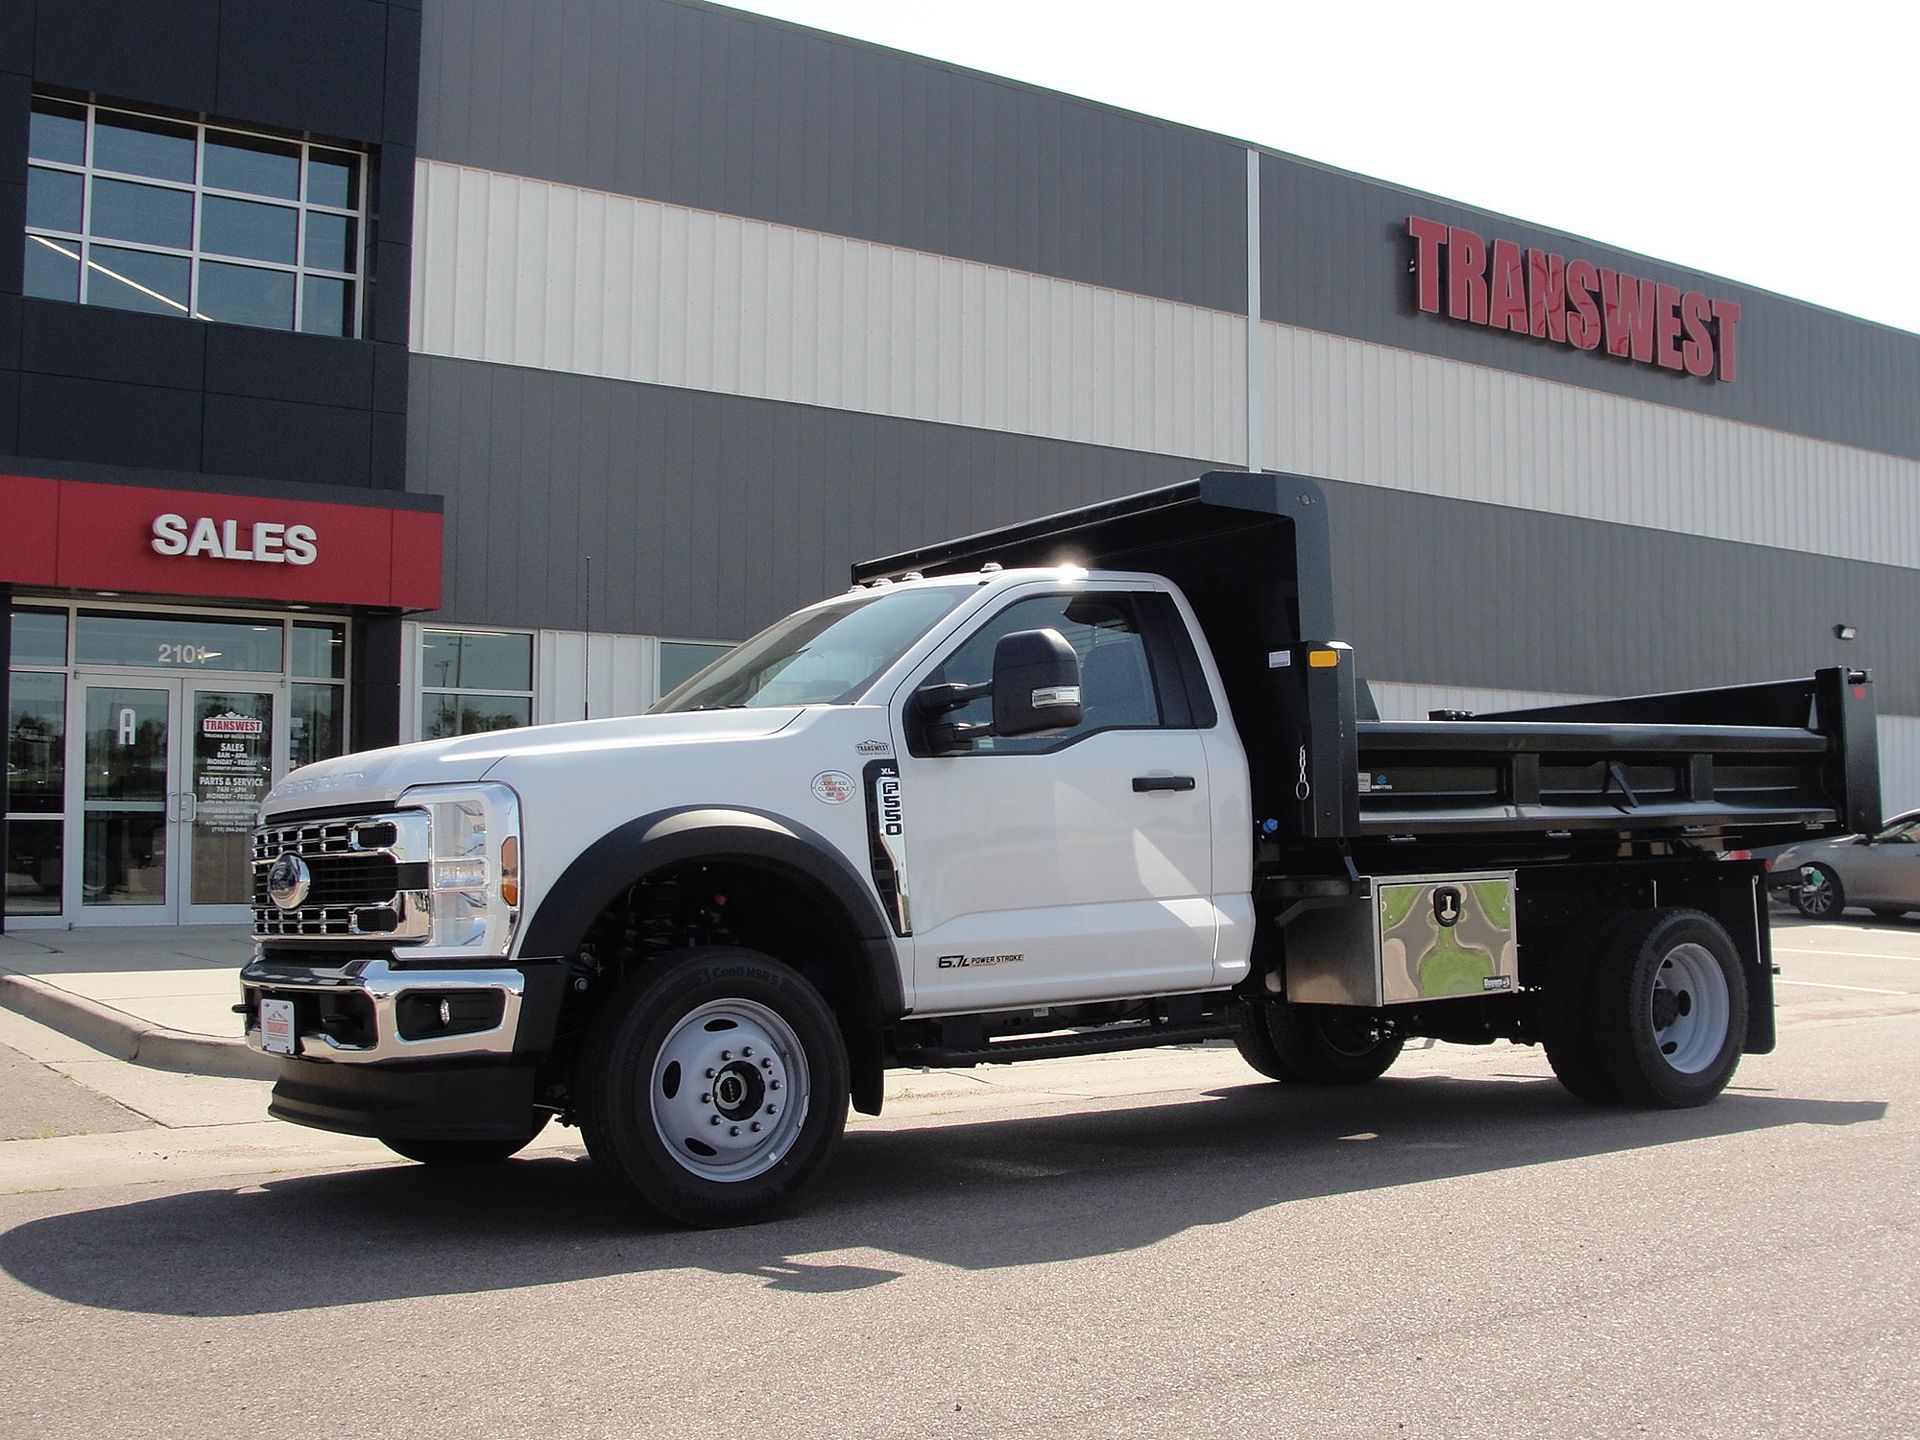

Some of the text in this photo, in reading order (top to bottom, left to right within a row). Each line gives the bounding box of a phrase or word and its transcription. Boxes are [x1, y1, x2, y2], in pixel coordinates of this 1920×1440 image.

[1405, 215, 1742, 382] TRANSWEST
[151, 513, 318, 565] SALES
[158, 643, 206, 664] 2101
[119, 708, 136, 745] A
[205, 720, 261, 731] TRANSWEST
[220, 743, 245, 752] SALES
[881, 767, 896, 775] XL
[200, 776, 264, 787] PARTS & SERVICE
[882, 781, 903, 836] F550
[938, 954, 970, 968] 6.7L
[971, 956, 995, 965] POWER
[996, 953, 1024, 963] STROKE
